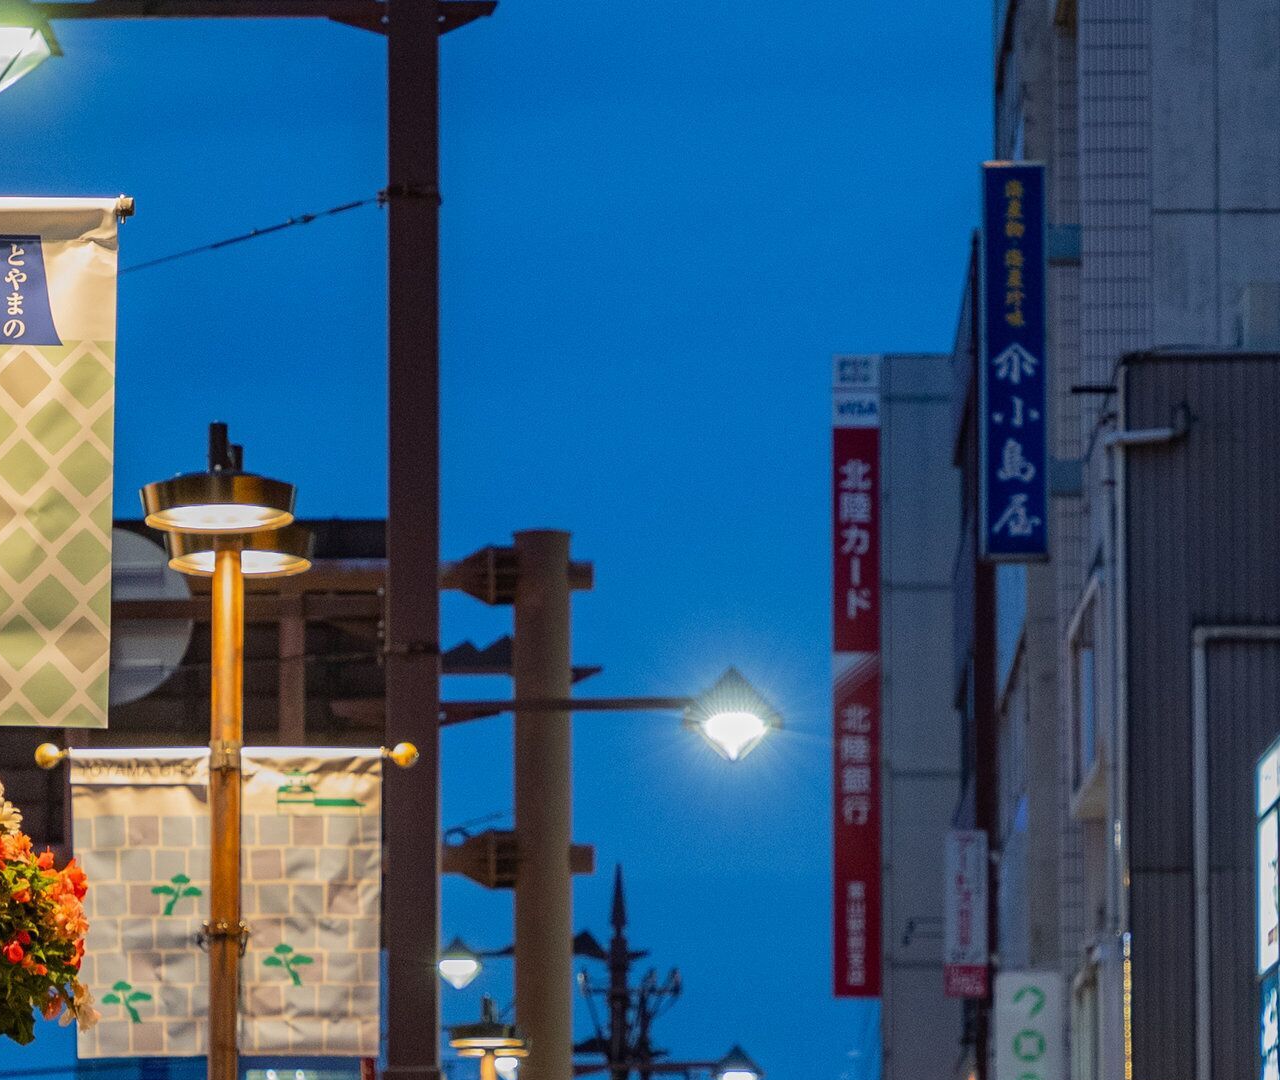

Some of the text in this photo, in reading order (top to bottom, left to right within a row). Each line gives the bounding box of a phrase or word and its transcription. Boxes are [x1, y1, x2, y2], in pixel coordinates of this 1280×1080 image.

[3, 244, 27, 340] とやまの
[993, 396, 1041, 535] 小島屋
[838, 458, 872, 620] 北陸カード
[841, 704, 871, 826] 北陸銀行
